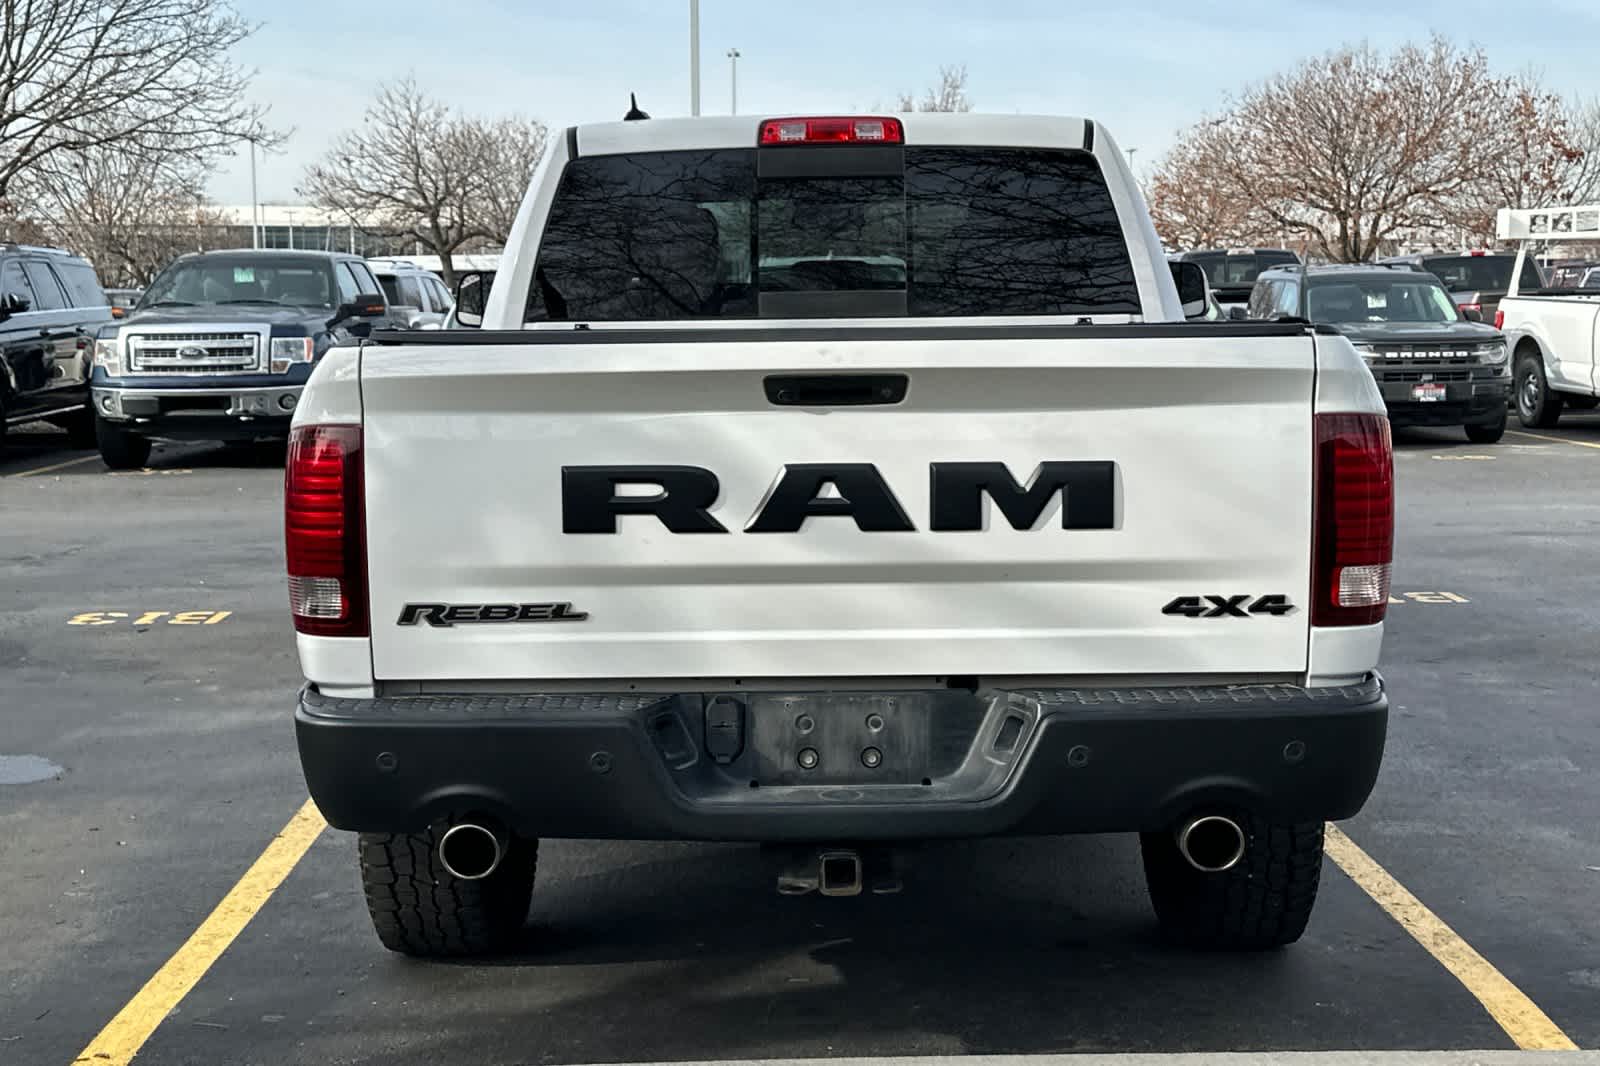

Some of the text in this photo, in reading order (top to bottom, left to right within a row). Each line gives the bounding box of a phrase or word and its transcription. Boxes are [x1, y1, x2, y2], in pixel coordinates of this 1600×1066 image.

[561, 460, 1121, 534] RAM
[397, 602, 589, 628] REBEL
[1161, 594, 1297, 618] 4X4
